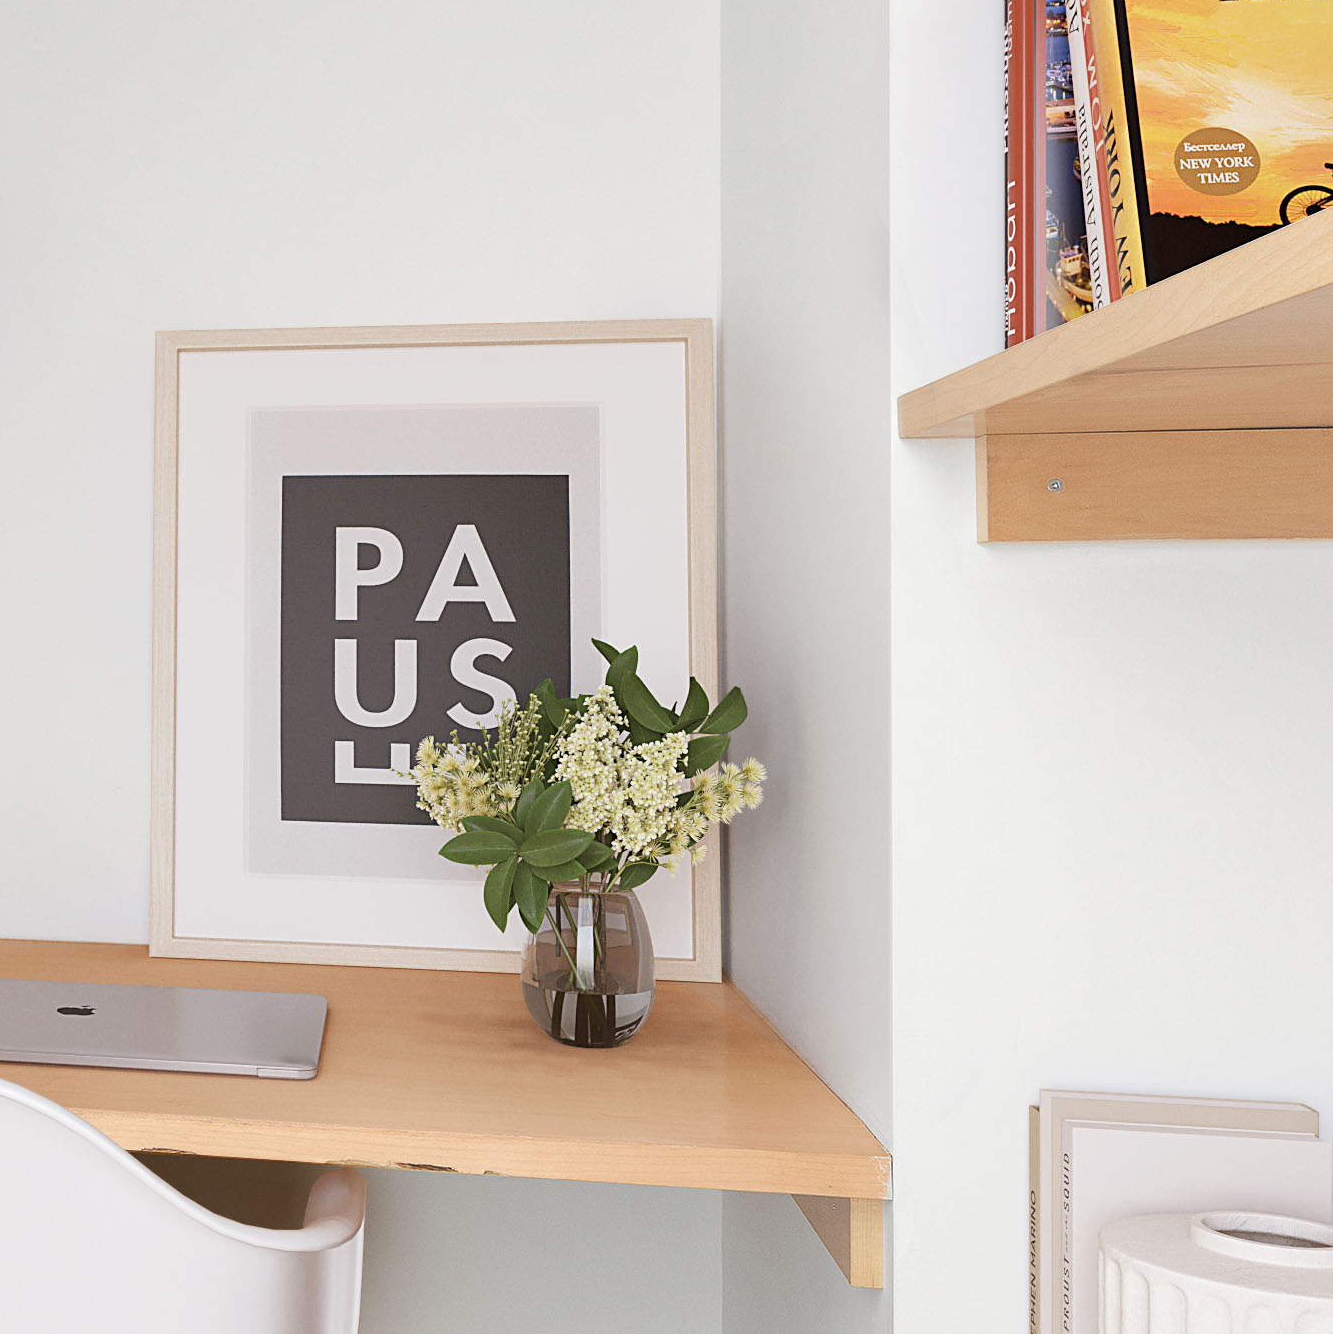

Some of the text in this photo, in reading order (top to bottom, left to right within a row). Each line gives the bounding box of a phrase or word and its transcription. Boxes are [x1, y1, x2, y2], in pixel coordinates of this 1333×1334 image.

[1078, 103, 1096, 226] Australia
[1103, 107, 1125, 229] YORK
[1179, 156, 1255, 170] NEW YORK
[1183, 142, 1246, 153] Бестселлер
[1197, 172, 1240, 184] TIMES
[1116, 235, 1133, 296] EW
[334, 523, 517, 622] PA
[334, 637, 518, 730] US
